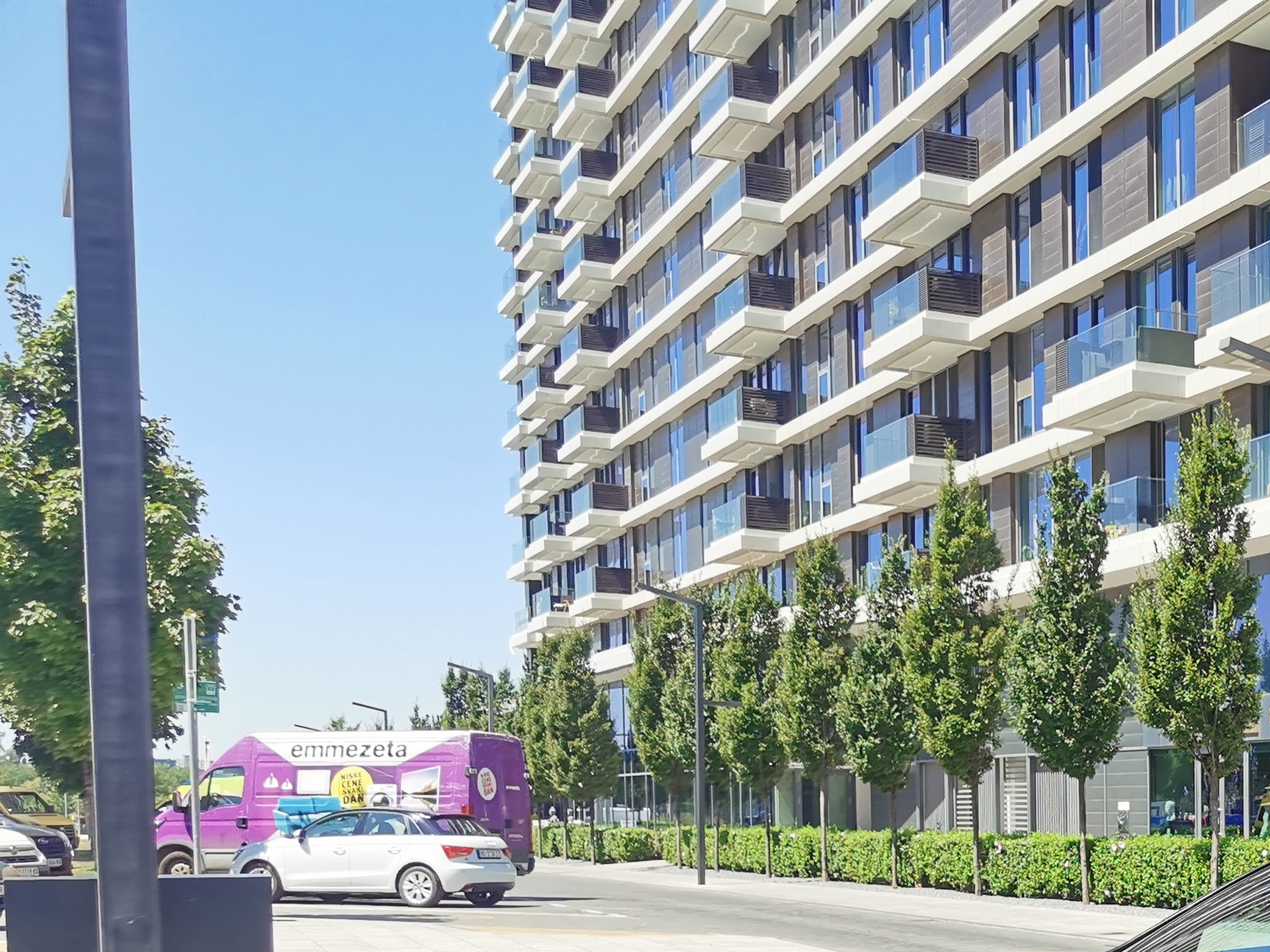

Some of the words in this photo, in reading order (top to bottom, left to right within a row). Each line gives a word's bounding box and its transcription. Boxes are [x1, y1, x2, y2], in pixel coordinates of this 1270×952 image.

[291, 741, 407, 758] emmezeta
[341, 772, 362, 780] NISKE
[342, 779, 362, 788] CENE
[343, 793, 365, 804] DAN
